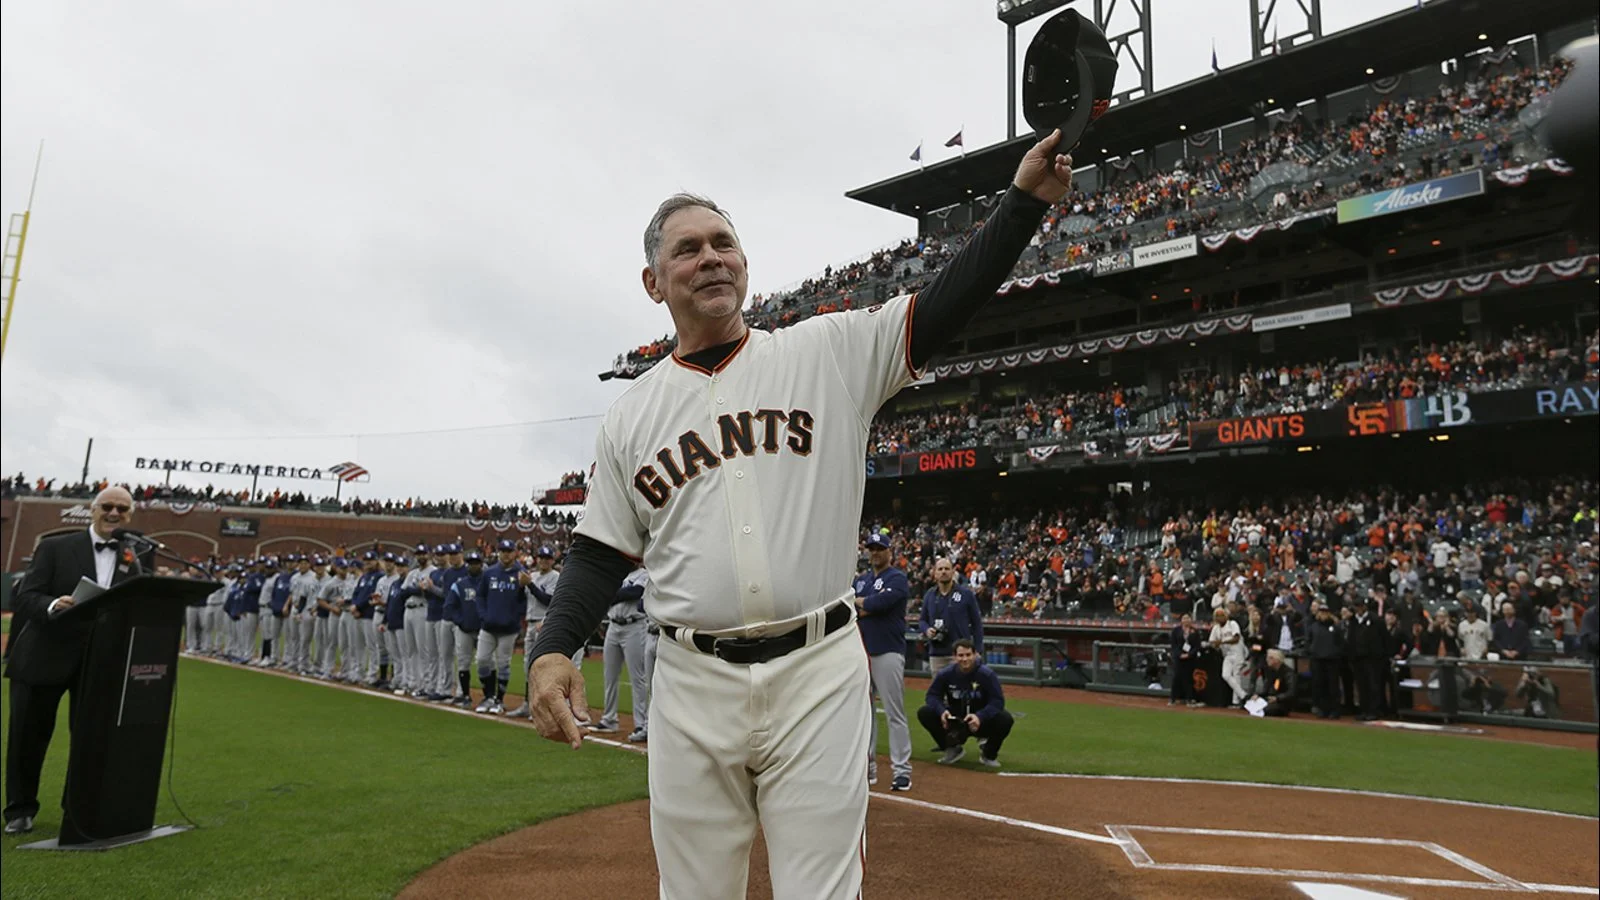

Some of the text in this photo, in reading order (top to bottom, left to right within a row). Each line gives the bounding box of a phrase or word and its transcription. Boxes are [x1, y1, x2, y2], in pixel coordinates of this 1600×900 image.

[1374, 184, 1442, 212] Alaska
[1096, 254, 1117, 268] NBC
[1139, 243, 1193, 260] WE INVESTIGATE
[1218, 415, 1304, 443] GIANTS
[135, 457, 322, 479] BANK OF AMERICA
[633, 408, 814, 509] GIANTS
[919, 449, 976, 472] GIANTS
